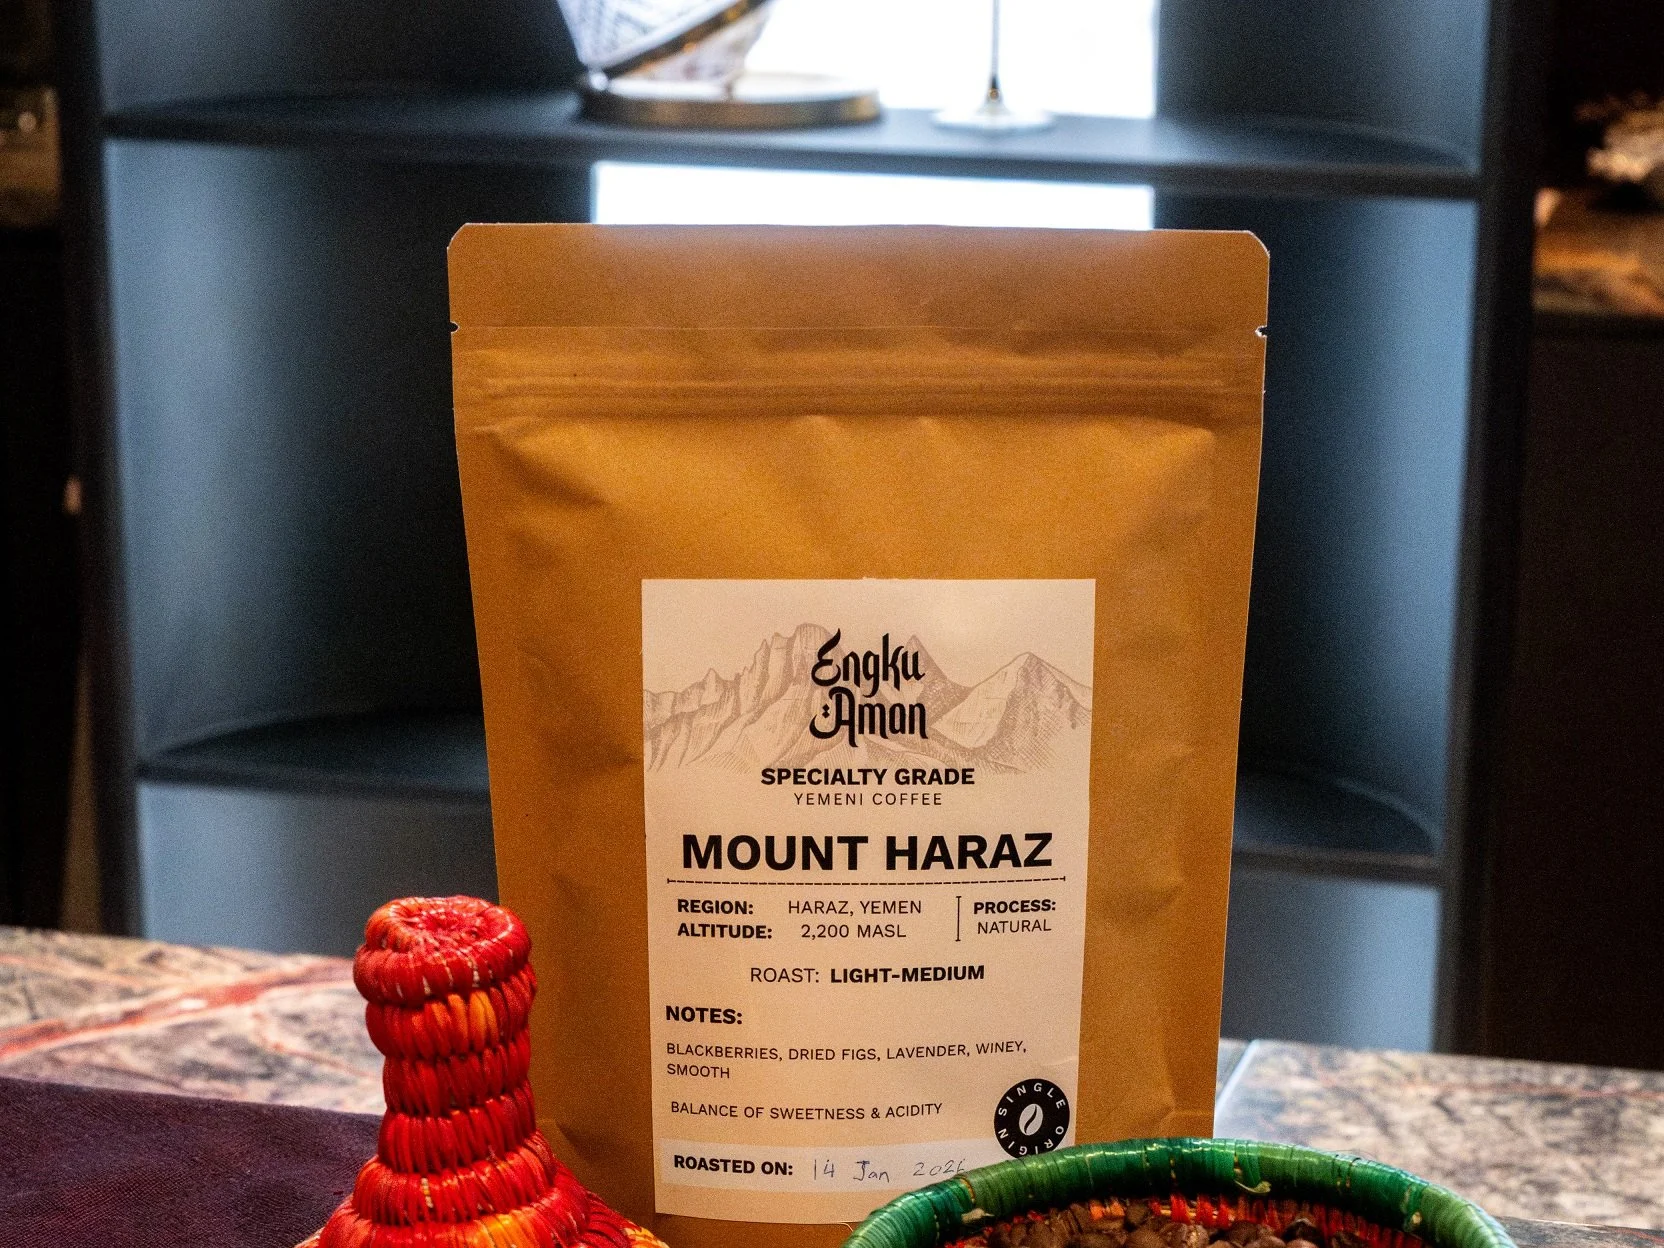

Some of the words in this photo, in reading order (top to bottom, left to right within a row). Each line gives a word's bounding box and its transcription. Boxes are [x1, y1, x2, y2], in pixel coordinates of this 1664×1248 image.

[811, 628, 925, 698] Engku
[809, 686, 928, 748] Aman
[760, 767, 888, 786] SPECIALTY
[894, 767, 975, 786] GRADE
[794, 792, 863, 806] YEMENI
[872, 792, 942, 806] COFFEE
[682, 834, 869, 871] MOUNT
[885, 832, 1053, 871] HARAZ
[677, 898, 754, 915] REGION:
[788, 900, 854, 917] HARAZ,
[859, 900, 922, 915] YEMEN
[973, 898, 1056, 915] PROCESS:
[677, 922, 773, 940] ALTITUDE:
[801, 923, 850, 941] 2,200
[857, 923, 907, 938] MASL
[977, 919, 1052, 935] NATURAL
[750, 967, 821, 983] ROAST:
[830, 964, 985, 984] LIGHT-MEDIUM
[665, 1005, 743, 1025] NOTES:
[666, 1042, 784, 1064] BLACKBERRIES,
[788, 1048, 836, 1061] DRIED
[841, 1048, 881, 1062] FIGS,
[886, 1044, 970, 1060] LAVENDER,
[975, 1040, 1027, 1055] WINEY,
[666, 1063, 730, 1079] SMOOTH
[997, 1081, 1067, 1118] SINGLE
[670, 1100, 738, 1119] BALANCE
[743, 1106, 765, 1119] OF
[769, 1107, 865, 1120] SWEETNESS
[870, 1107, 881, 1119] &
[885, 1102, 943, 1119] ACIDITY
[997, 1125, 1066, 1157] ORIGIN
[673, 1154, 756, 1174] ROASTED
[760, 1161, 793, 1176] ON:
[813, 1159, 835, 1180] 14
[853, 1160, 890, 1183] Jan
